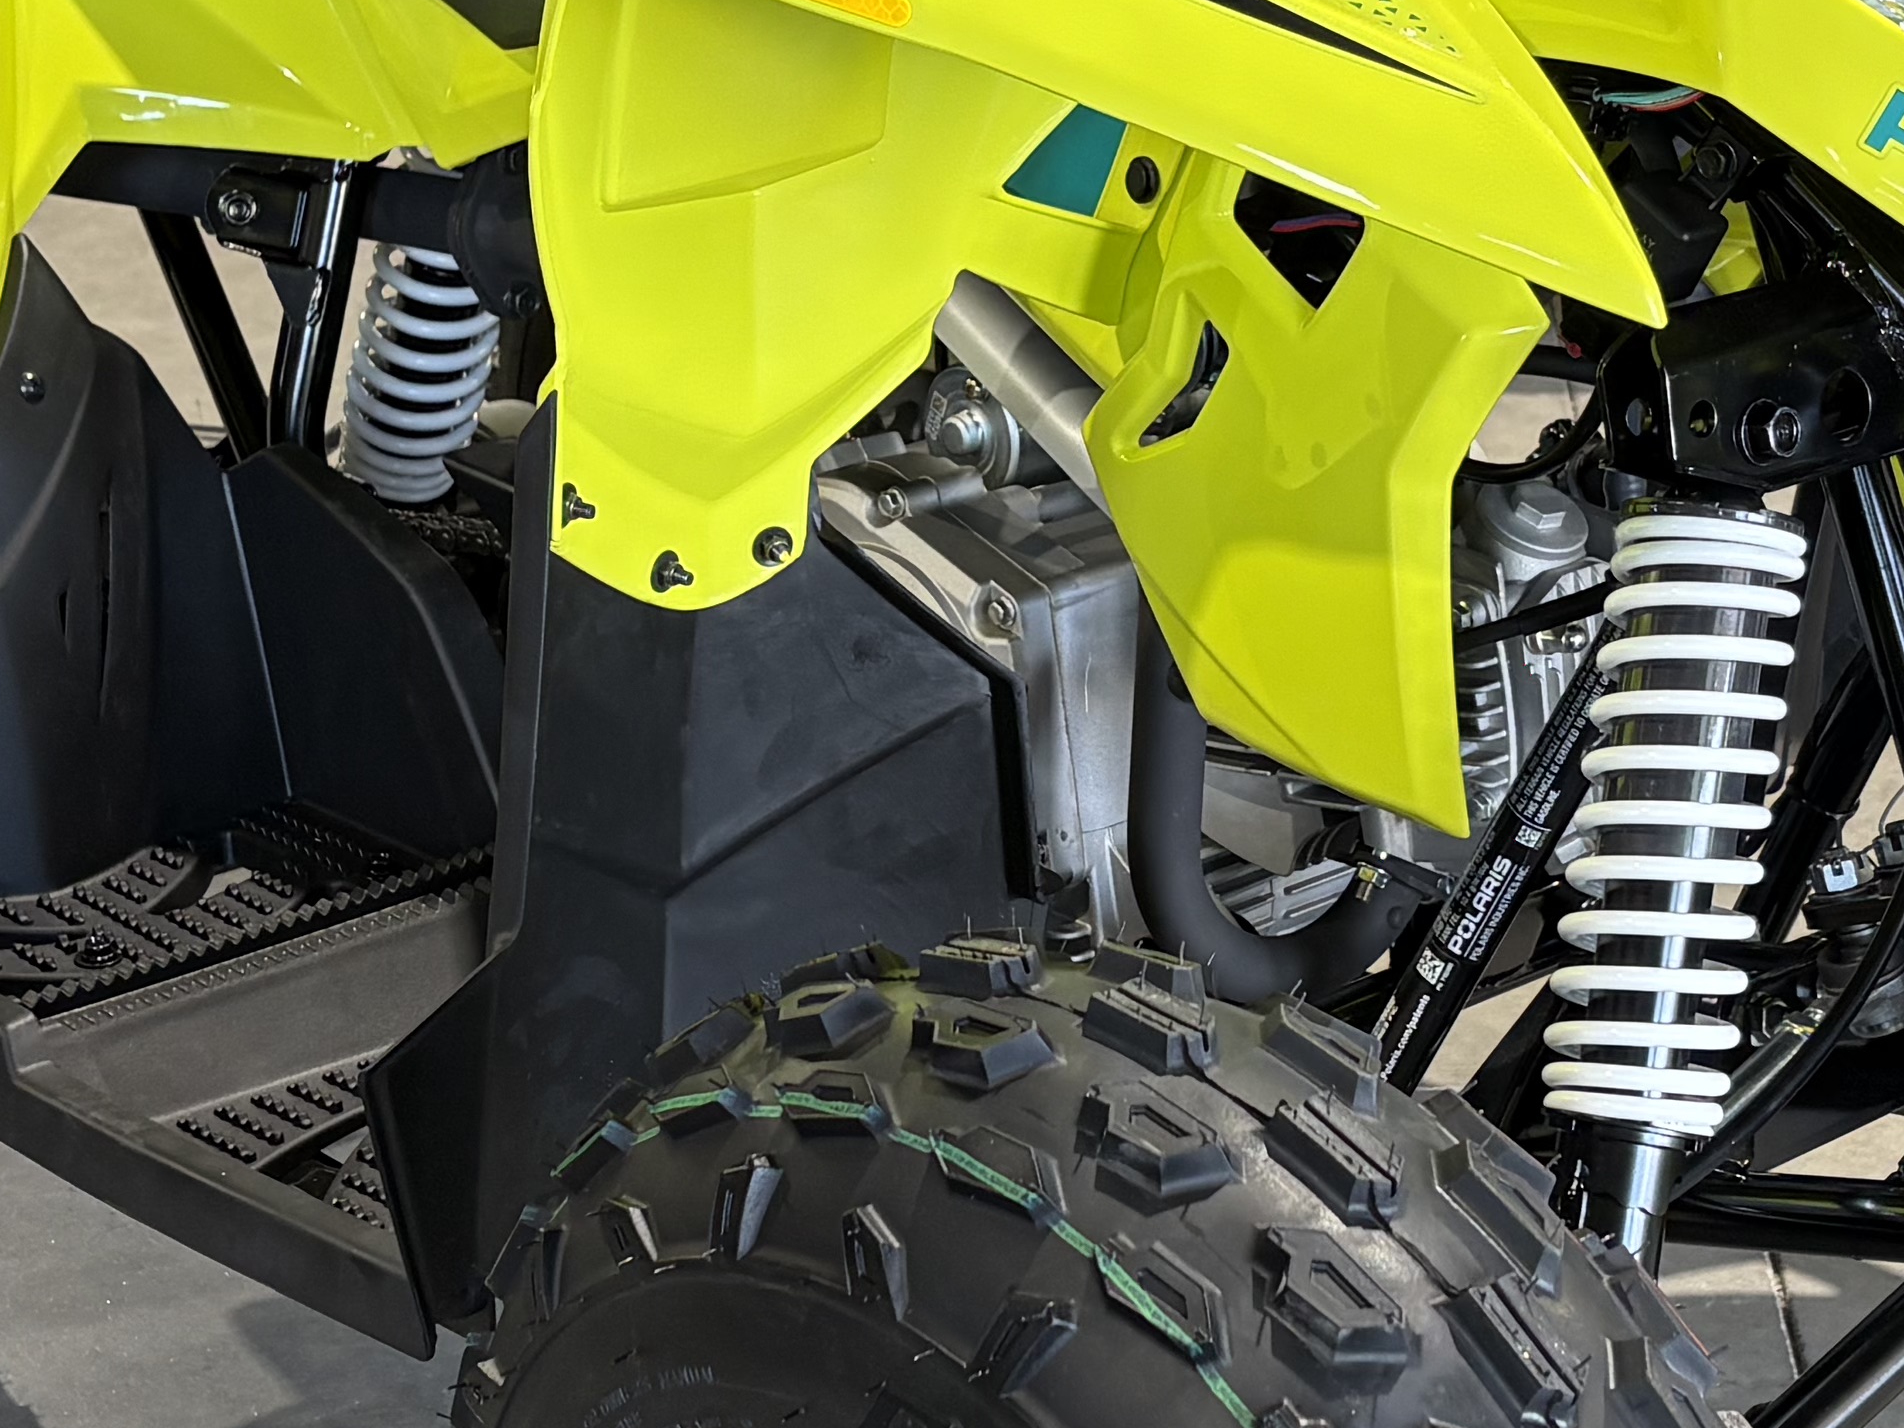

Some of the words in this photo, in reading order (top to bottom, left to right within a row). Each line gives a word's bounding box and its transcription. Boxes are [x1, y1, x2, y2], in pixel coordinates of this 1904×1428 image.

[1523, 799, 1540, 819] THIS
[1532, 771, 1556, 803] VEHICLE
[1573, 715, 1587, 729] TO
[1534, 785, 1562, 825] GASOLINE.
[1445, 853, 1515, 956] POLARIS
[1467, 923, 1496, 963] POLARIS
[1488, 878, 1522, 928] INDUSTRIES
